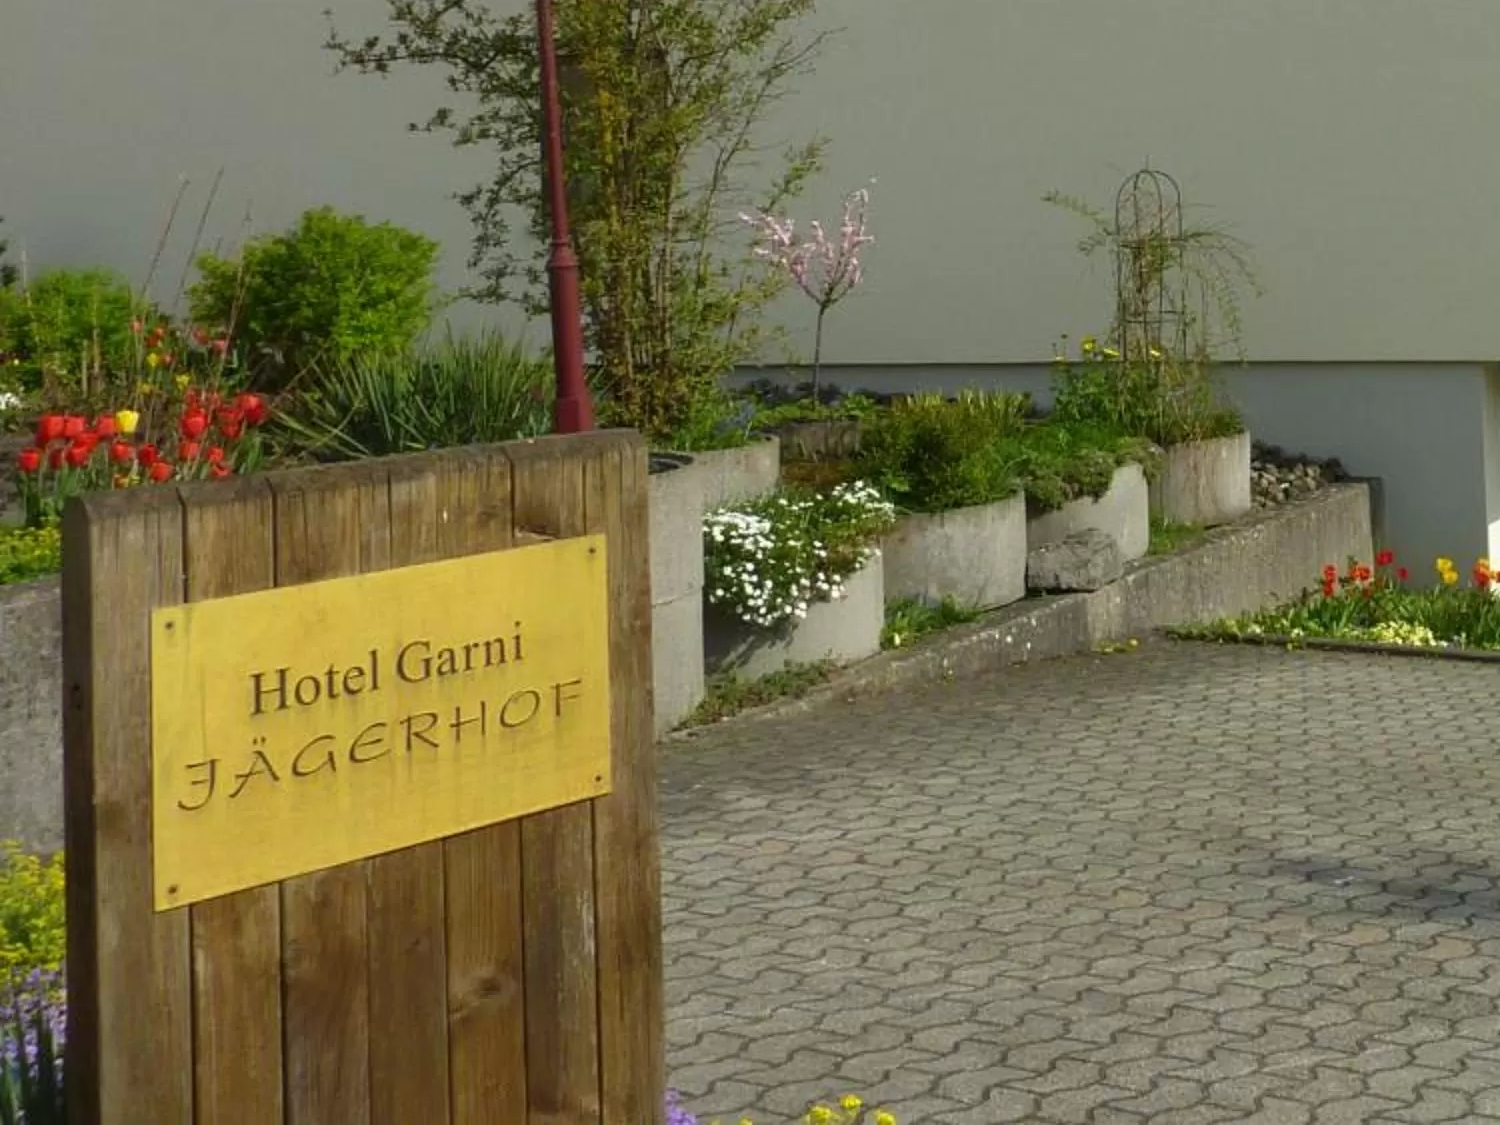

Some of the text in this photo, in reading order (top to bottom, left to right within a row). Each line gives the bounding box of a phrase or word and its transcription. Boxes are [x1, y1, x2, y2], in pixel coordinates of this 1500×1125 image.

[249, 620, 525, 716] Hotel Garni
[177, 679, 584, 811] JÄGERHOF
